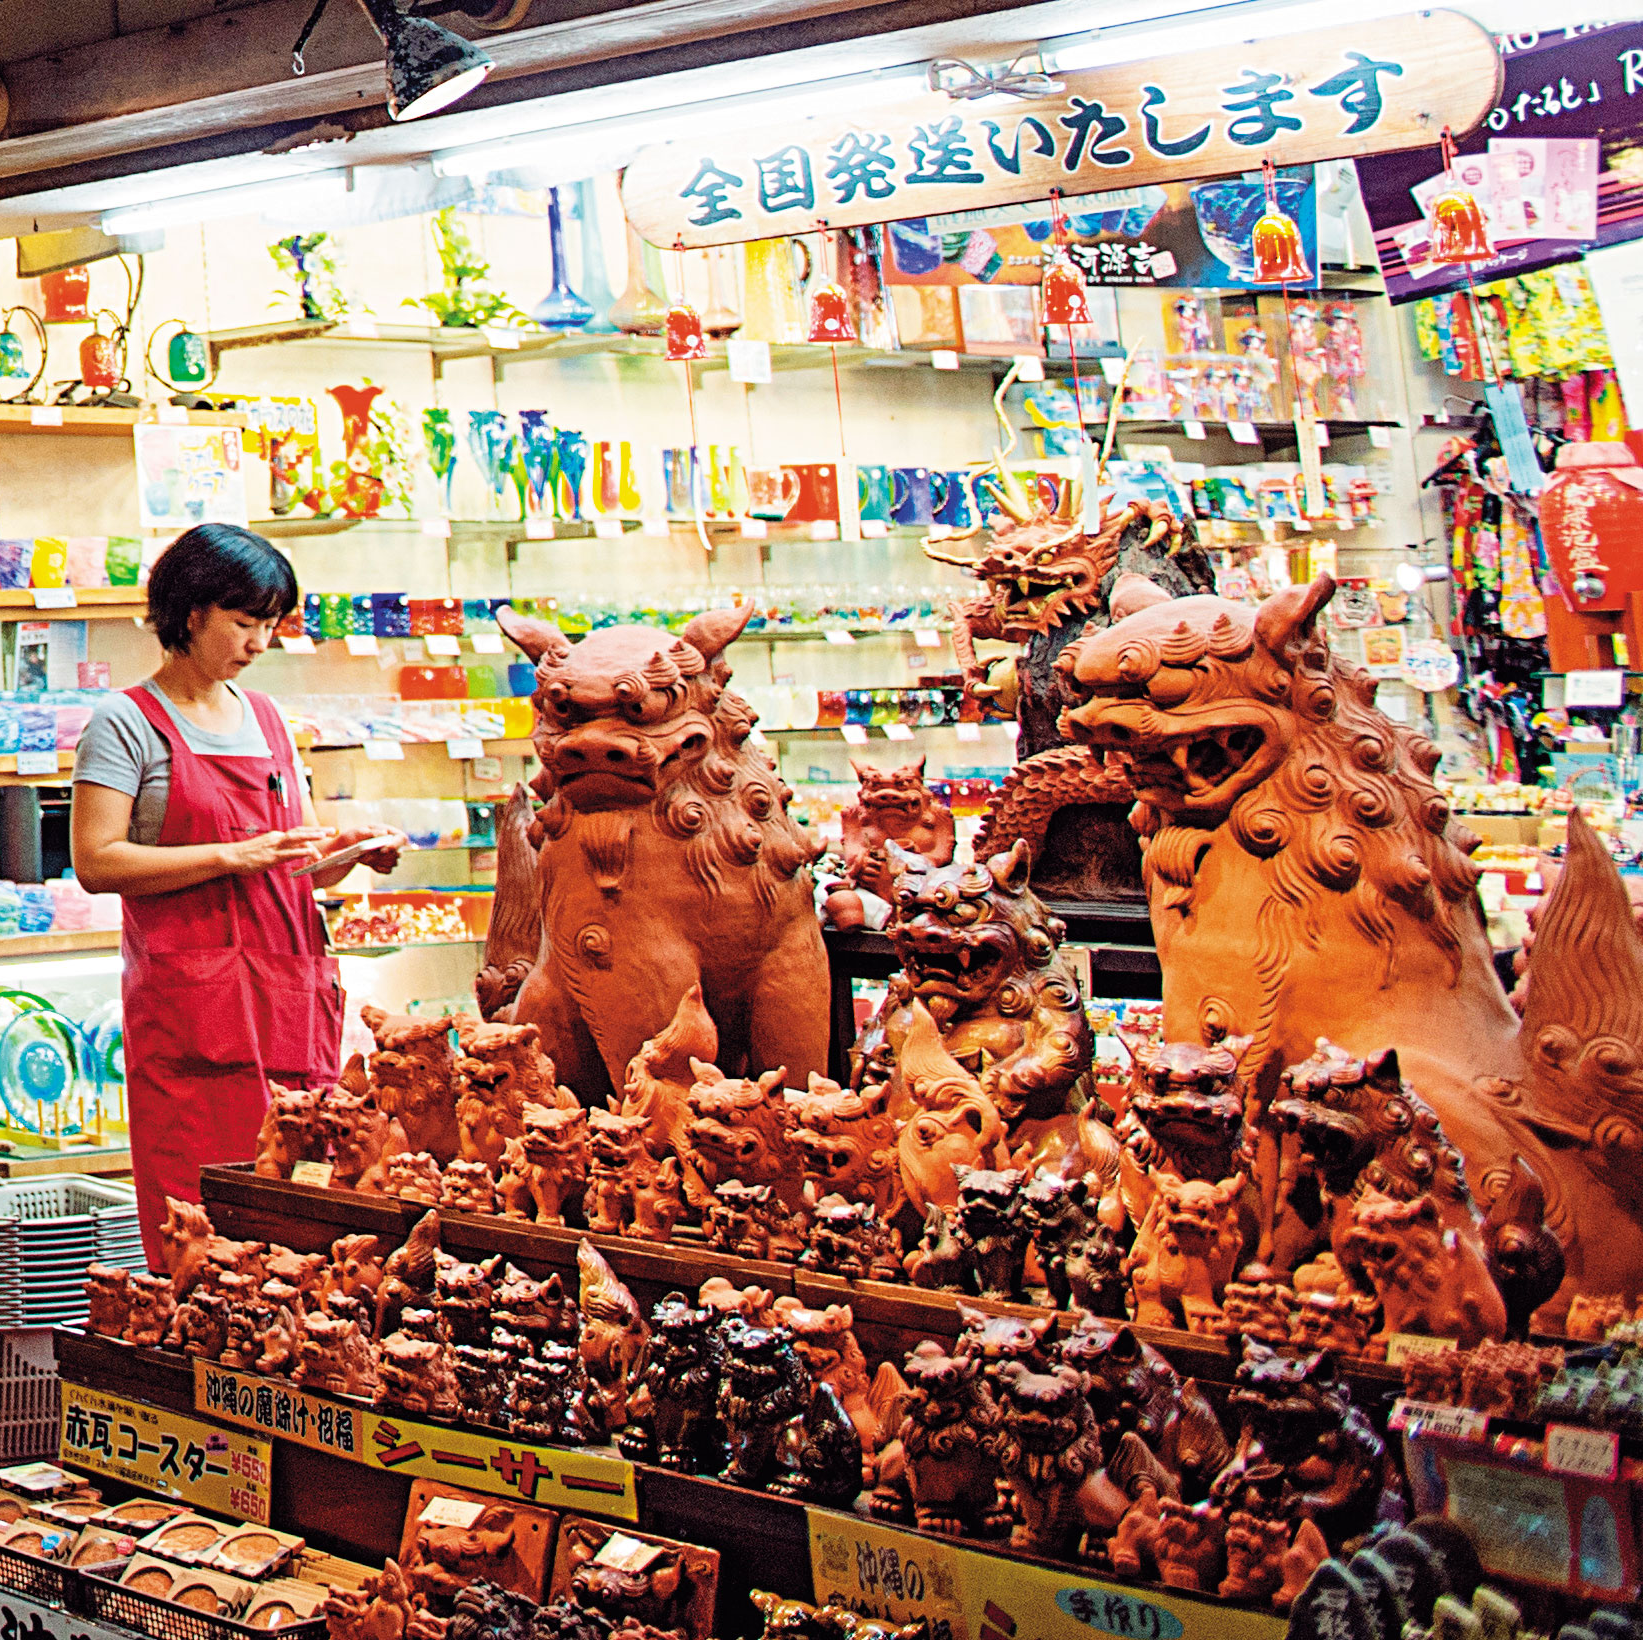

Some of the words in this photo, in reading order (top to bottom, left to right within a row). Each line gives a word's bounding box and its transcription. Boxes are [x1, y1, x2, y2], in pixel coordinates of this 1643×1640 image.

[678, 51, 1405, 228] 全国発送いたします
[65, 1404, 229, 1483] 赤瓦コースター
[371, 1419, 626, 1499] シーサー
